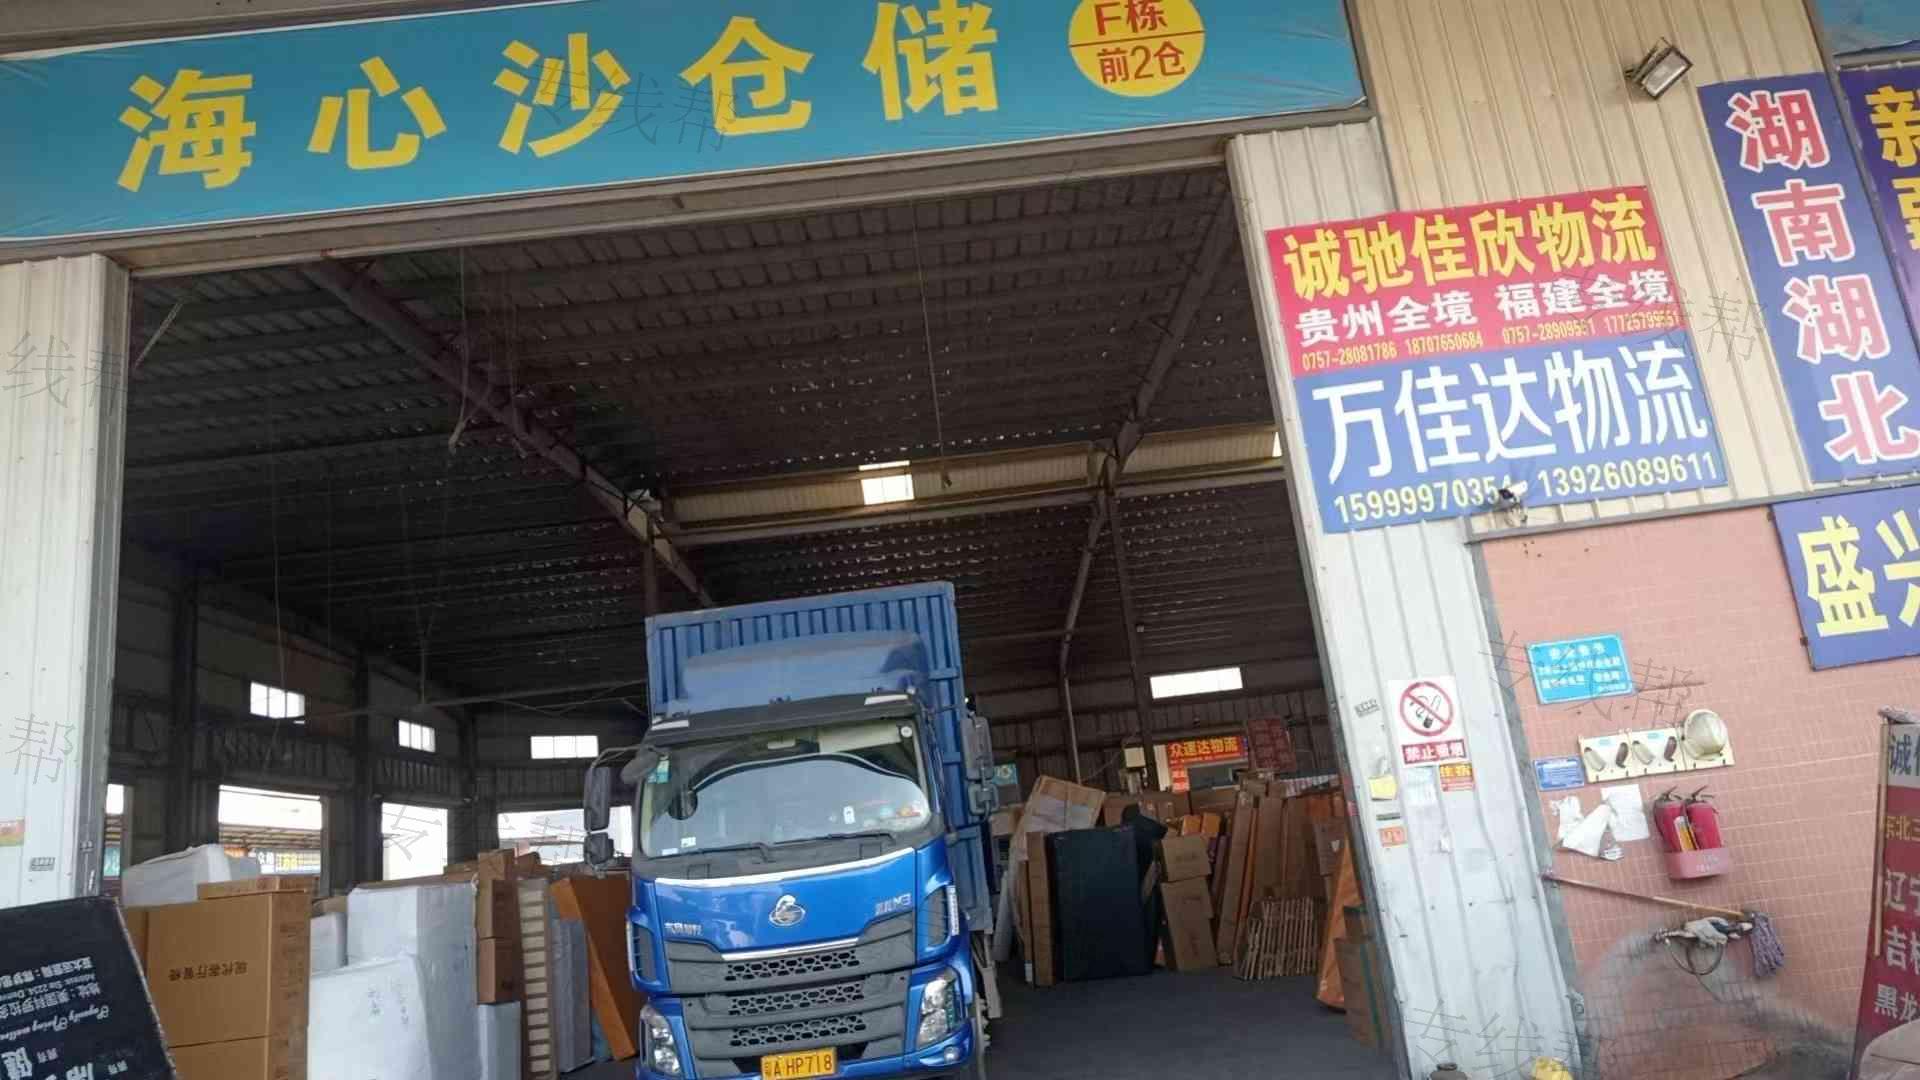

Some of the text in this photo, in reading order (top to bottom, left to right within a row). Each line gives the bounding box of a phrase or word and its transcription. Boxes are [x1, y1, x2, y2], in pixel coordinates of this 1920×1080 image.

[1095, 0, 1167, 35] F栋
[117, 0, 999, 192] 海心沙仓储
[1097, 41, 1186, 84] 前2仓
[1283, 194, 1657, 301] 诚驰佳欣物流
[1295, 269, 1675, 347] 贵州全境 福建全境
[1313, 339, 1710, 484] 万佳达物流
[1538, 453, 1717, 498] 13926089611
